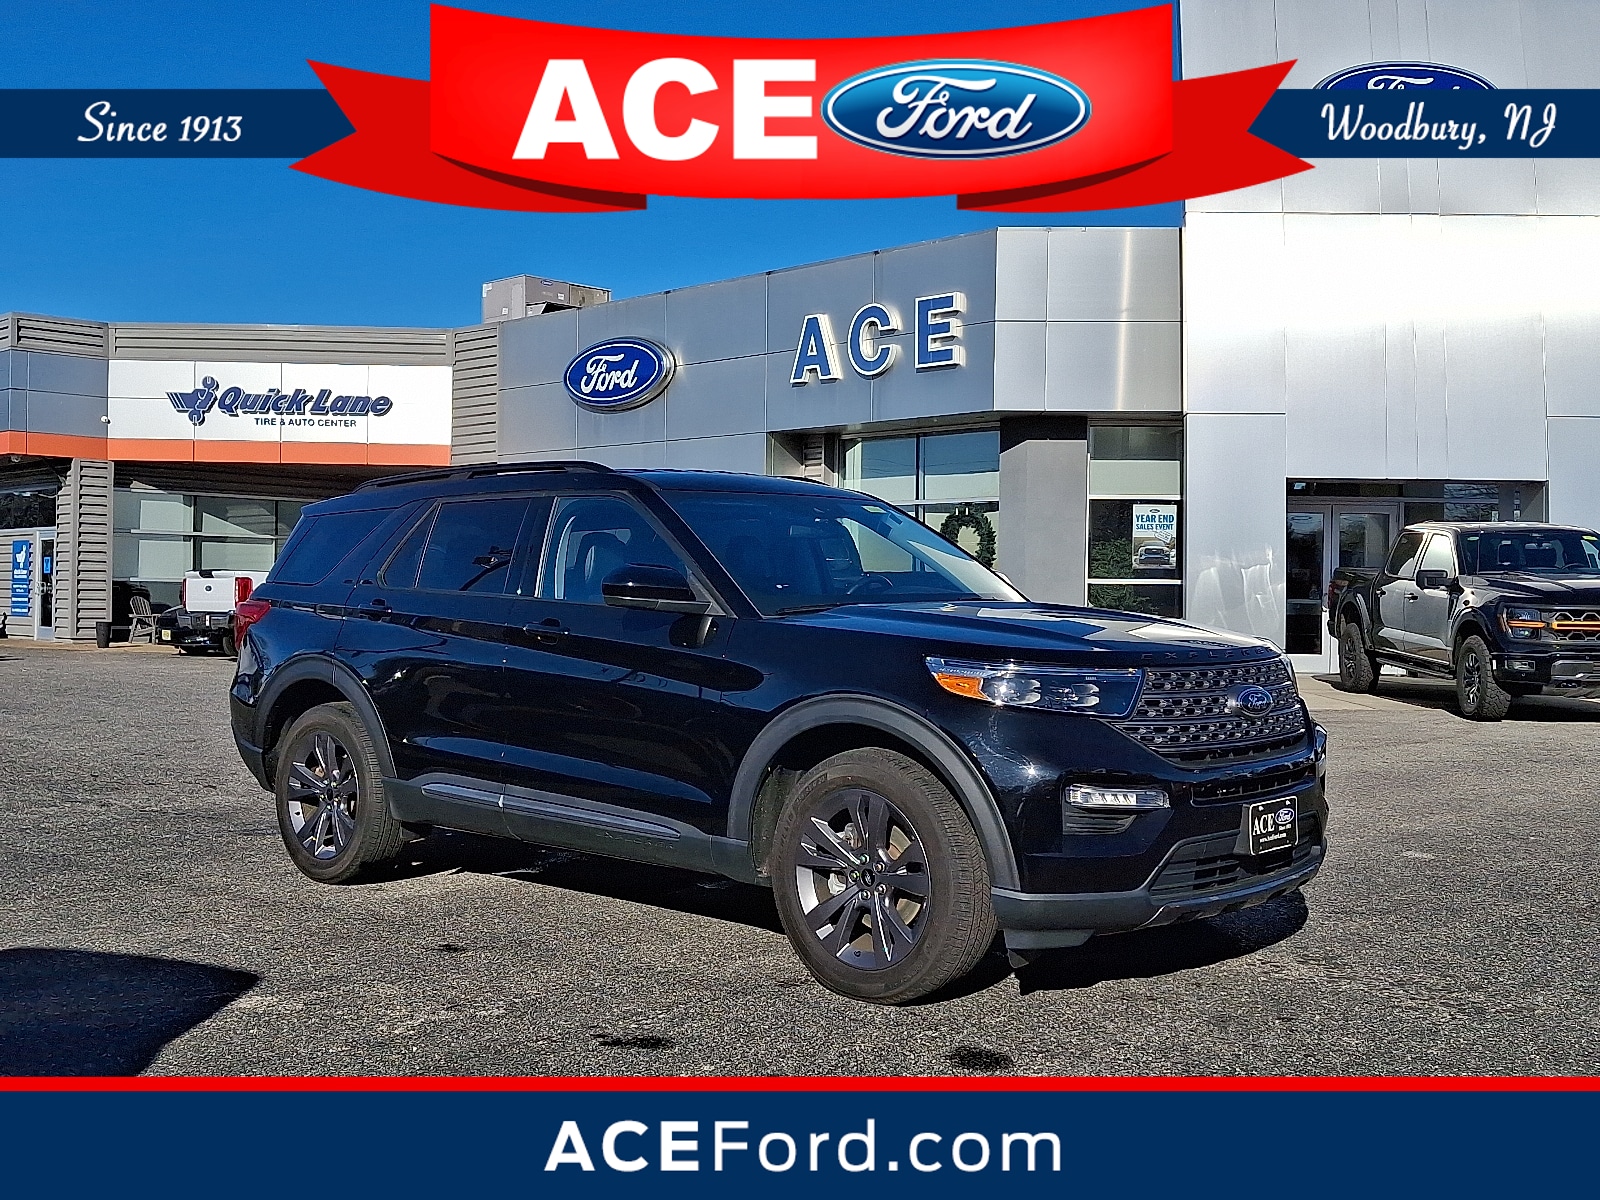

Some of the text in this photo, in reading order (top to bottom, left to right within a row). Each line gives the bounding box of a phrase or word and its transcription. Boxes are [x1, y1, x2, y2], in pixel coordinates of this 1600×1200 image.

[790, 291, 967, 388] ACE
[580, 353, 640, 394] Ford
[217, 386, 393, 417] Quick Lane
[254, 417, 357, 428] TIRE & AUTO CENTER
[1135, 514, 1175, 523] YEAR END
[1252, 813, 1275, 835] ACE
